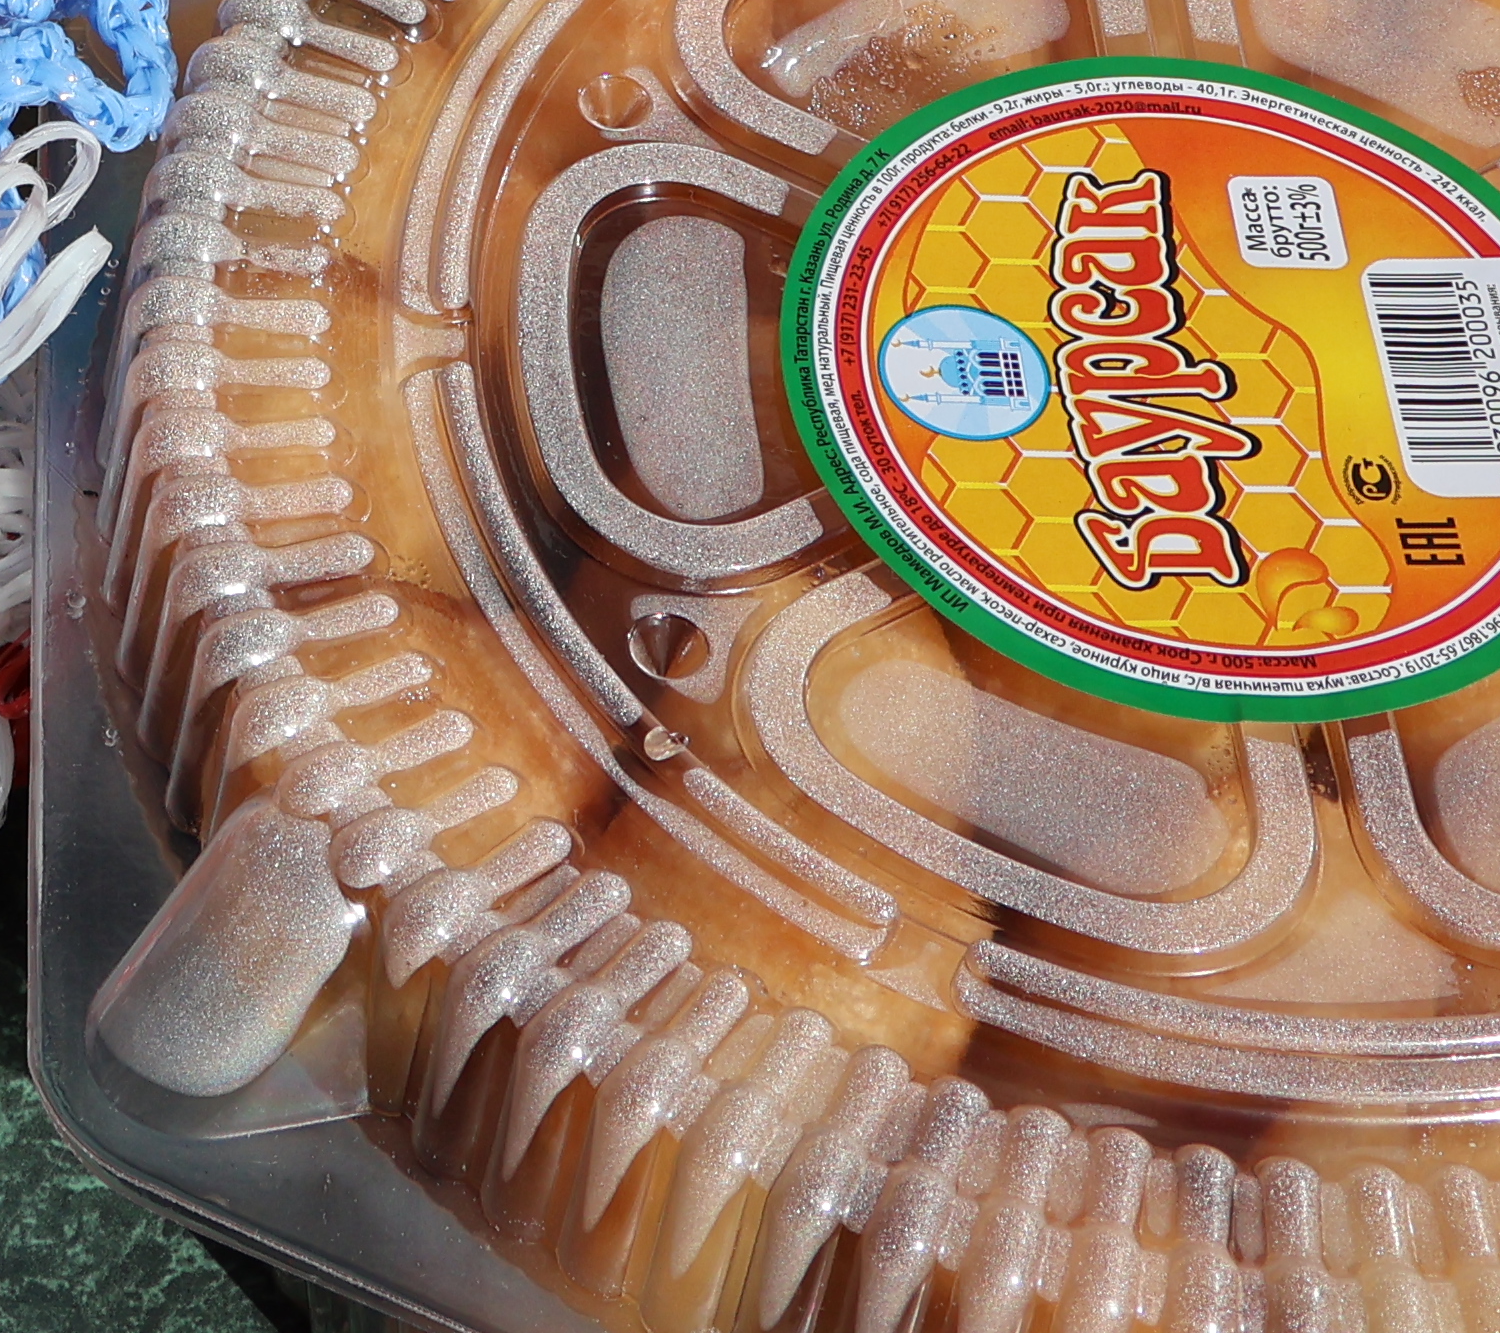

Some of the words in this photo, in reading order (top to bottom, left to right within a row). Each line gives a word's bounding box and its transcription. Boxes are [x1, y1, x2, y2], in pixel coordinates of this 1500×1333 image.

[1024, 89, 1064, 105] жиры
[1112, 80, 1184, 93] углеводы
[1196, 83, 1238, 101] 40,1г.
[949, 111, 988, 133] белки
[1031, 101, 1202, 126] baursak-2020@mail.ru
[1241, 90, 1358, 140] Энергетическая
[988, 117, 1031, 141] email:
[871, 156, 883, 167] 7
[900, 127, 955, 170] продукта:
[1359, 133, 1423, 174] ценность
[860, 167, 876, 182] д.
[881, 164, 904, 186] 100г.
[916, 142, 972, 187] 256-64-22
[874, 185, 883, 194] в
[1432, 173, 1459, 196] 242
[825, 180, 864, 220] Родина
[1456, 193, 1487, 223] ккал.
[820, 220, 836, 239] ул.
[842, 193, 877, 238] ценность
[1262, 185, 1295, 258] брутто:
[1285, 183, 1331, 262] 500г±3%
[799, 239, 827, 285] Казань
[820, 237, 849, 289] Пищевая
[803, 285, 812, 296] г.
[794, 297, 811, 364] Татарстан
[817, 286, 833, 372] натуральный.
[839, 316, 856, 348] (917)
[1455, 279, 1497, 360] 200035
[840, 348, 856, 367] +7
[819, 372, 835, 396] мед
[1050, 170, 1261, 590] Баурсак
[800, 366, 831, 448] Республика
[851, 389, 869, 416] тел.
[827, 398, 857, 454] пищевая,
[861, 417, 885, 459] суток
[824, 449, 860, 495] Адрес:
[850, 455, 874, 483] сода
[881, 458, 897, 476] 30
[853, 497, 883, 531] М.И.
[870, 483, 939, 562] растительное,
[921, 514, 945, 531] до
[879, 528, 945, 592] Мамедов
[938, 532, 1031, 605] температуре
[939, 561, 980, 596] масло
[939, 592, 970, 614] ИП
[1033, 600, 1067, 623] при
[981, 590, 1067, 648] сахар-песок,
[1069, 618, 1153, 653] хранения
[1070, 641, 1138, 674] куриное,
[1156, 647, 1203, 665] Срок
[1205, 653, 1218, 665] г.
[1223, 656, 1254, 670] 500
[1258, 655, 1317, 669] Масса:
[1141, 666, 1181, 685] яйцо
[1215, 679, 1304, 692] пшеничная
[1307, 675, 1344, 692] мука
[1345, 664, 1401, 685] Состав:
